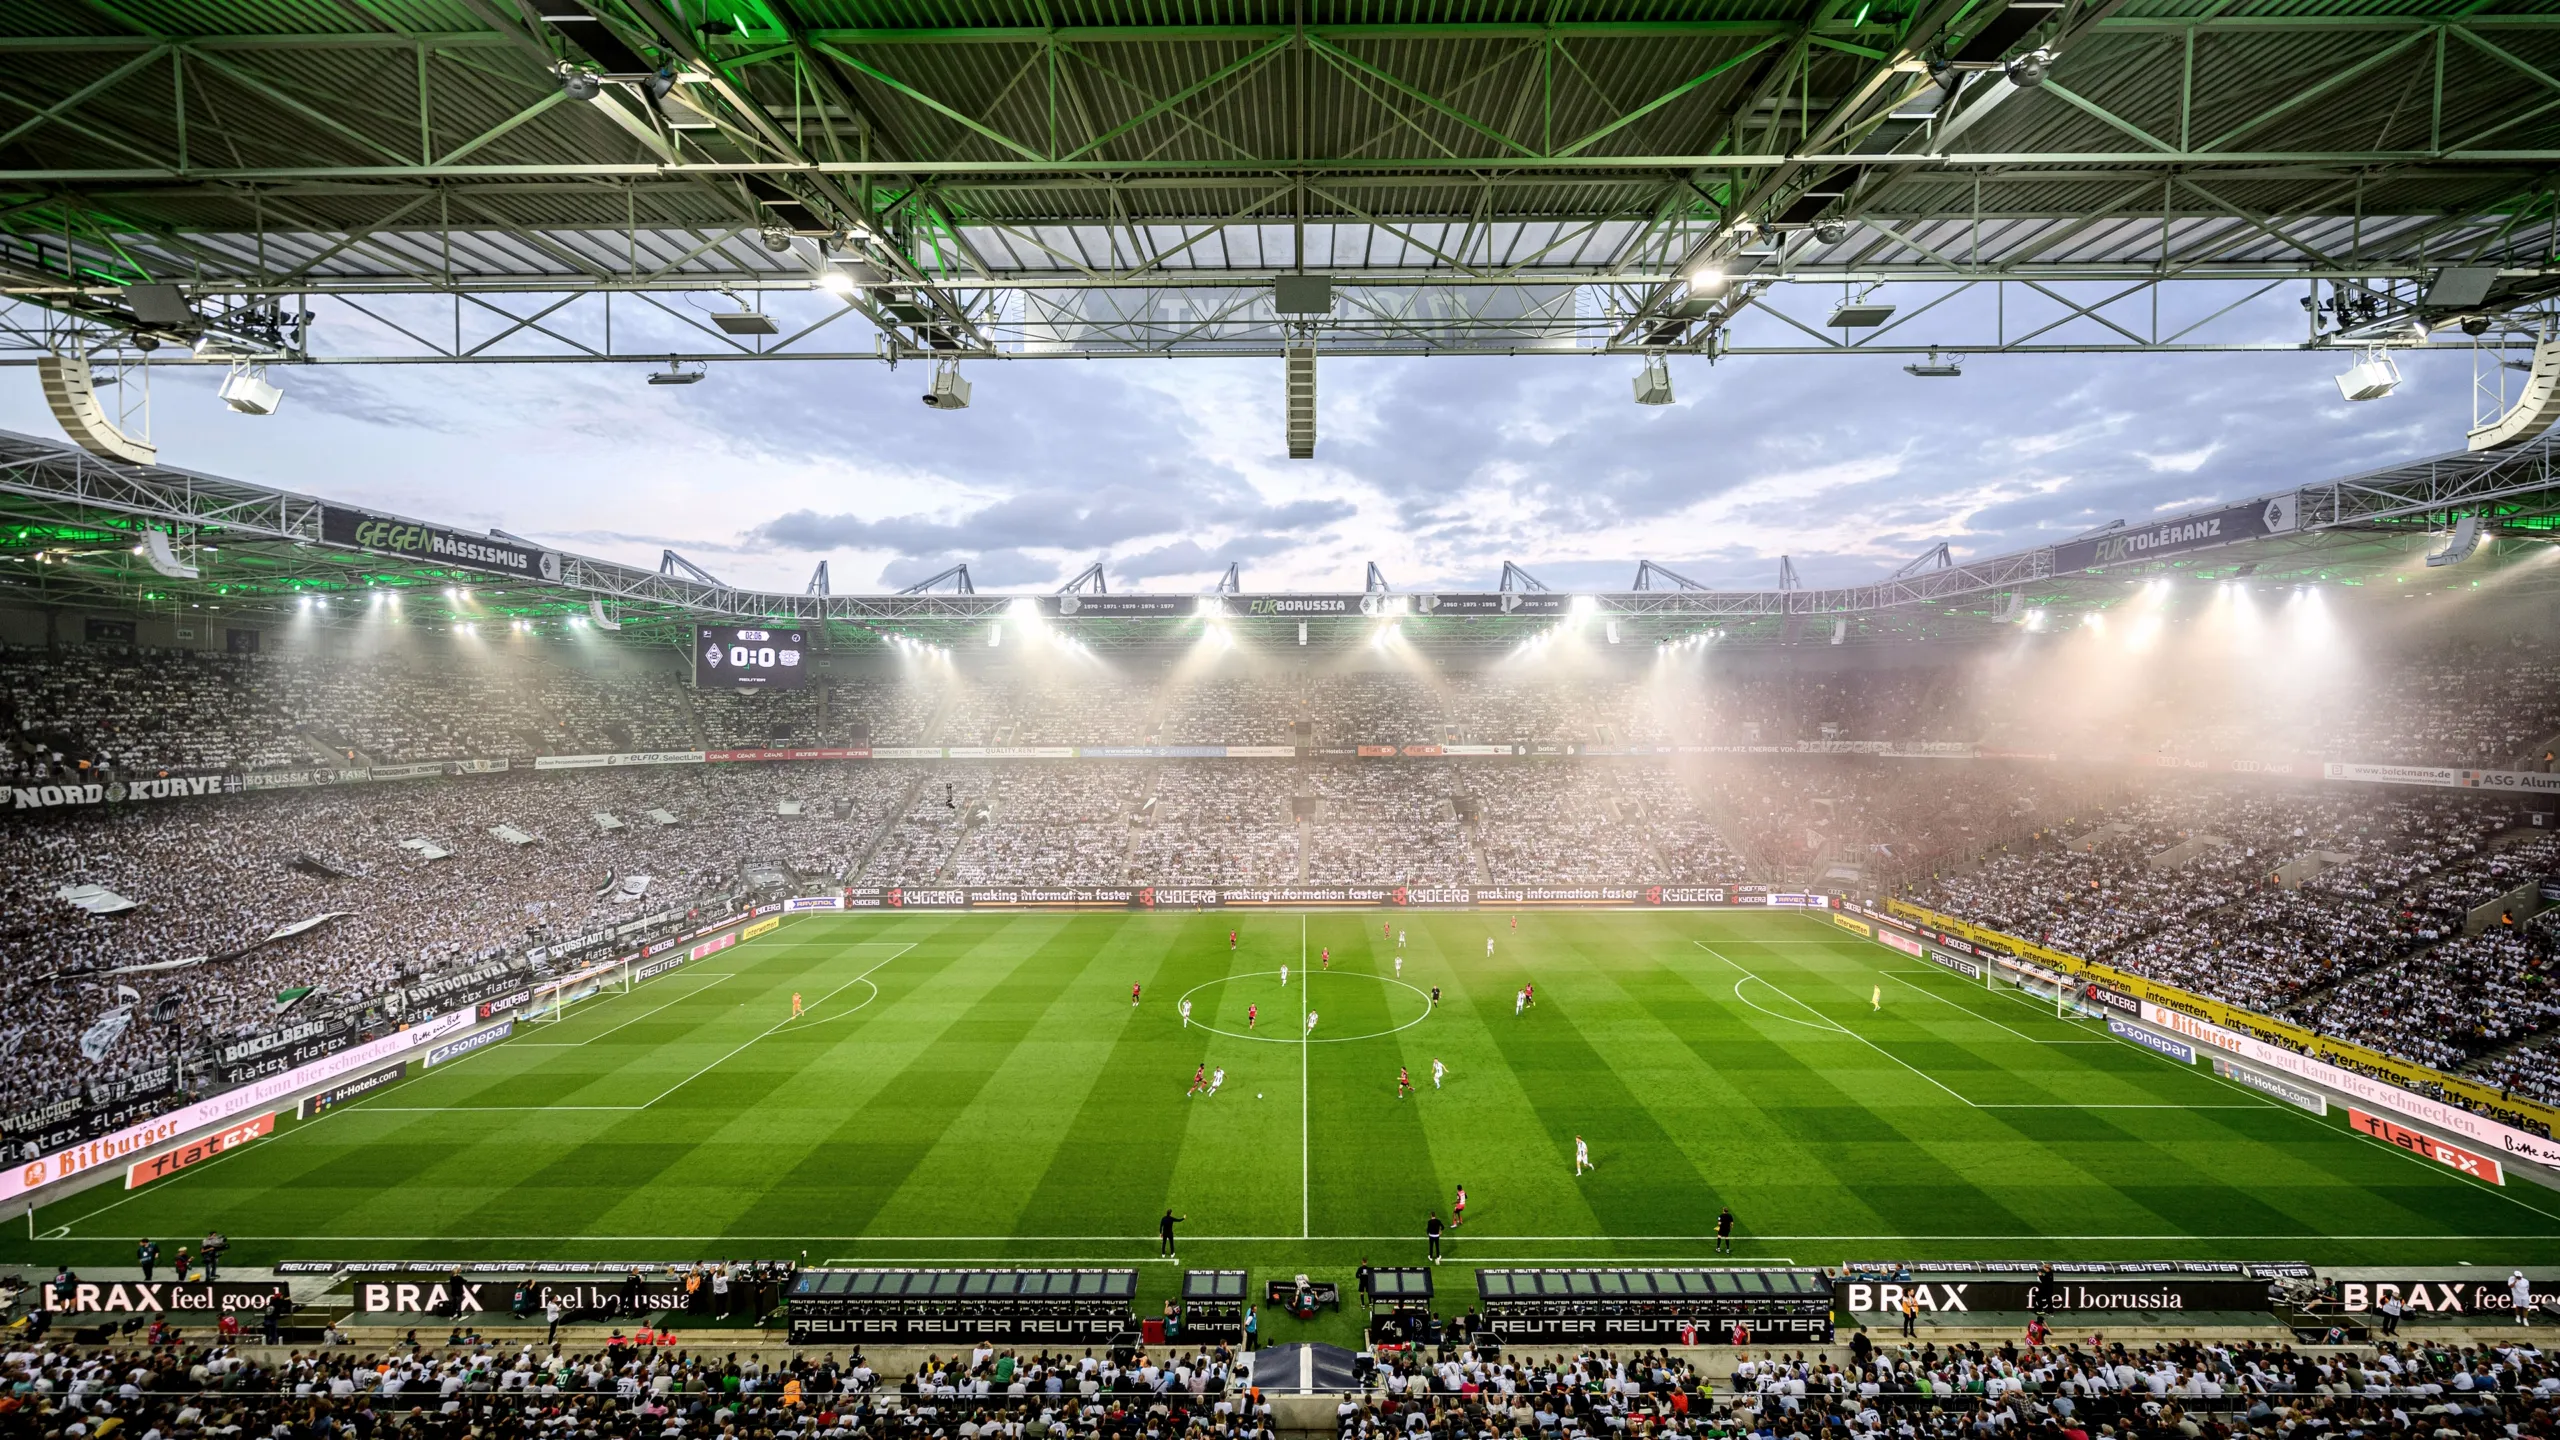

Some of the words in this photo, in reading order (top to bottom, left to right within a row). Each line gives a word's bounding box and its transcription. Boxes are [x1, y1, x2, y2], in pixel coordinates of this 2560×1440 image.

[2127, 518, 2221, 552] TOLERANZ
[356, 521, 436, 552] GEGEN
[434, 537, 527, 568] RASSISMUS
[1276, 600, 1346, 611] BORUSSIA
[745, 631, 762, 640] 02:06
[730, 646, 776, 668] 0:0
[663, 754, 703, 762] SelectLine
[2184, 758, 2208, 769] Audi
[2263, 763, 2293, 773] Audi
[2355, 766, 2451, 779] www.bolckmans.de
[246, 772, 310, 786] BORUSSIA
[2483, 774, 2515, 786] ASG
[12, 784, 104, 809] NORD
[129, 775, 222, 800] KURVE
[851, 898, 880, 906] KYOCERA
[903, 889, 965, 905] KYOCERA
[971, 889, 1017, 904] making
[1020, 888, 1094, 902] information
[1095, 889, 1131, 902] faster
[1155, 889, 1217, 905] KYOCERA
[1224, 889, 1271, 904] making
[1348, 888, 1384, 901] faster
[1407, 887, 1470, 904] KYOCERA
[1477, 888, 1523, 903] making
[1526, 887, 1598, 901] information
[1602, 887, 1640, 901] faster
[1661, 886, 1724, 903] KYOCERA
[1836, 917, 1869, 935] interwetten
[1945, 936, 1972, 954] KYOCERA
[639, 955, 684, 980] REUTER
[1931, 950, 1976, 978] REUTER
[408, 962, 509, 1002] SOTTOCULTURA
[490, 989, 530, 1014] KYOCERA
[2096, 988, 2137, 1012] KYOCERA
[2146, 986, 2208, 1019] interwetten
[450, 1023, 510, 1056] sonepar
[2126, 1026, 2188, 1058] sonepar
[2323, 1036, 2355, 1051] interwetten
[2378, 1053, 2414, 1070] interwetten
[2171, 1012, 2242, 1053] Bitburger
[2256, 1044, 2273, 1060] So
[2276, 1053, 2298, 1070] gut
[2302, 1060, 2338, 1084] kann
[2342, 1074, 2376, 1097] Bier
[2379, 1089, 2482, 1136] schmecken.
[2441, 1073, 2481, 1091] interwetten
[336, 1068, 398, 1100] H-Hotels.com
[2243, 1071, 2312, 1106] H-Hotels.com
[58, 1119, 179, 1178] Bitburger
[199, 1105, 220, 1121] So
[225, 1095, 251, 1115] gut
[254, 1079, 292, 1100] kann
[296, 1065, 326, 1085] Bier
[328, 1042, 400, 1073] schmecken.
[2510, 1095, 2556, 1115] interwetten
[0, 1096, 83, 1132] WILLICHER
[280, 1263, 333, 1271] REUTER
[344, 1263, 397, 1271] REUTER
[408, 1263, 461, 1271] REUTER
[473, 1263, 526, 1271] REUTER
[537, 1263, 590, 1271] REUTER
[602, 1263, 655, 1271] REUTER
[1920, 1263, 1977, 1271] REUTER
[1986, 1263, 2039, 1272] REUTER
[2052, 1263, 2106, 1272] REUTER
[2119, 1263, 2171, 1272] REUTER
[2184, 1262, 2238, 1272] REUTER
[171, 1286, 215, 1309] feel
[366, 1283, 484, 1312] BRAX
[1848, 1283, 1968, 1312] BRAX
[2078, 1286, 2183, 1309] borussia
[794, 1319, 898, 1332] REUTER
[907, 1319, 1011, 1332] REUTER
[1021, 1319, 1125, 1332] REUTER
[1188, 1323, 1241, 1331] REUTER
[1491, 1319, 1596, 1332] REUTER
